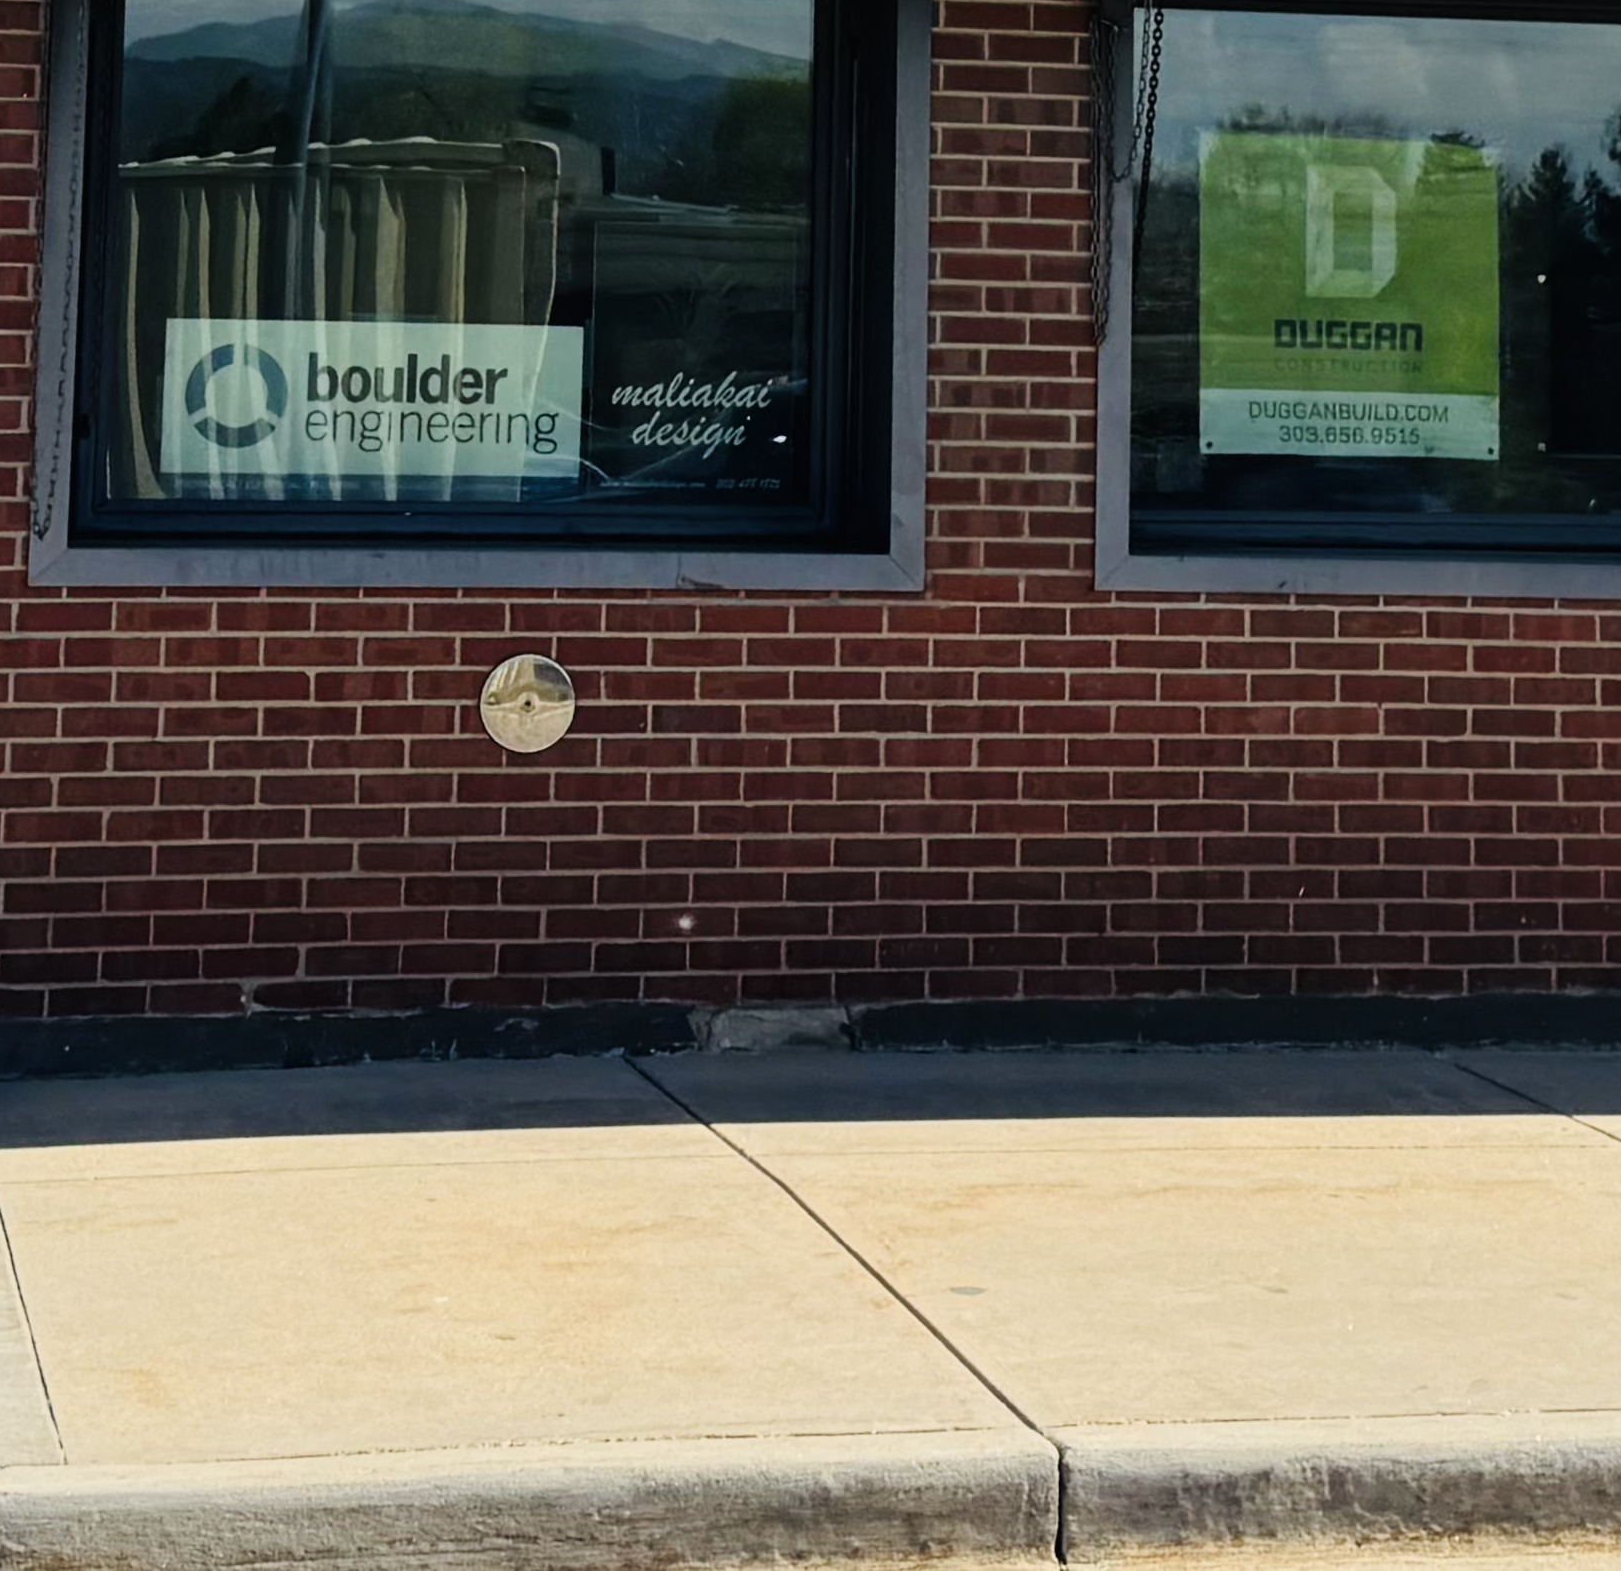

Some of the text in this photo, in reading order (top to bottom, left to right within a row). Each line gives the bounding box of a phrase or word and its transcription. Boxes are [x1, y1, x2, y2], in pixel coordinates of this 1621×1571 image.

[1305, 165, 1397, 299] D
[1274, 318, 1423, 352] DUGGAN
[307, 351, 508, 405] boulder
[1275, 358, 1423, 374] CONSTRUCTION
[611, 370, 772, 409] maliakai
[305, 409, 560, 454] engineering
[1248, 400, 1449, 424] DUGGANBUILD.COM
[631, 410, 747, 460] design
